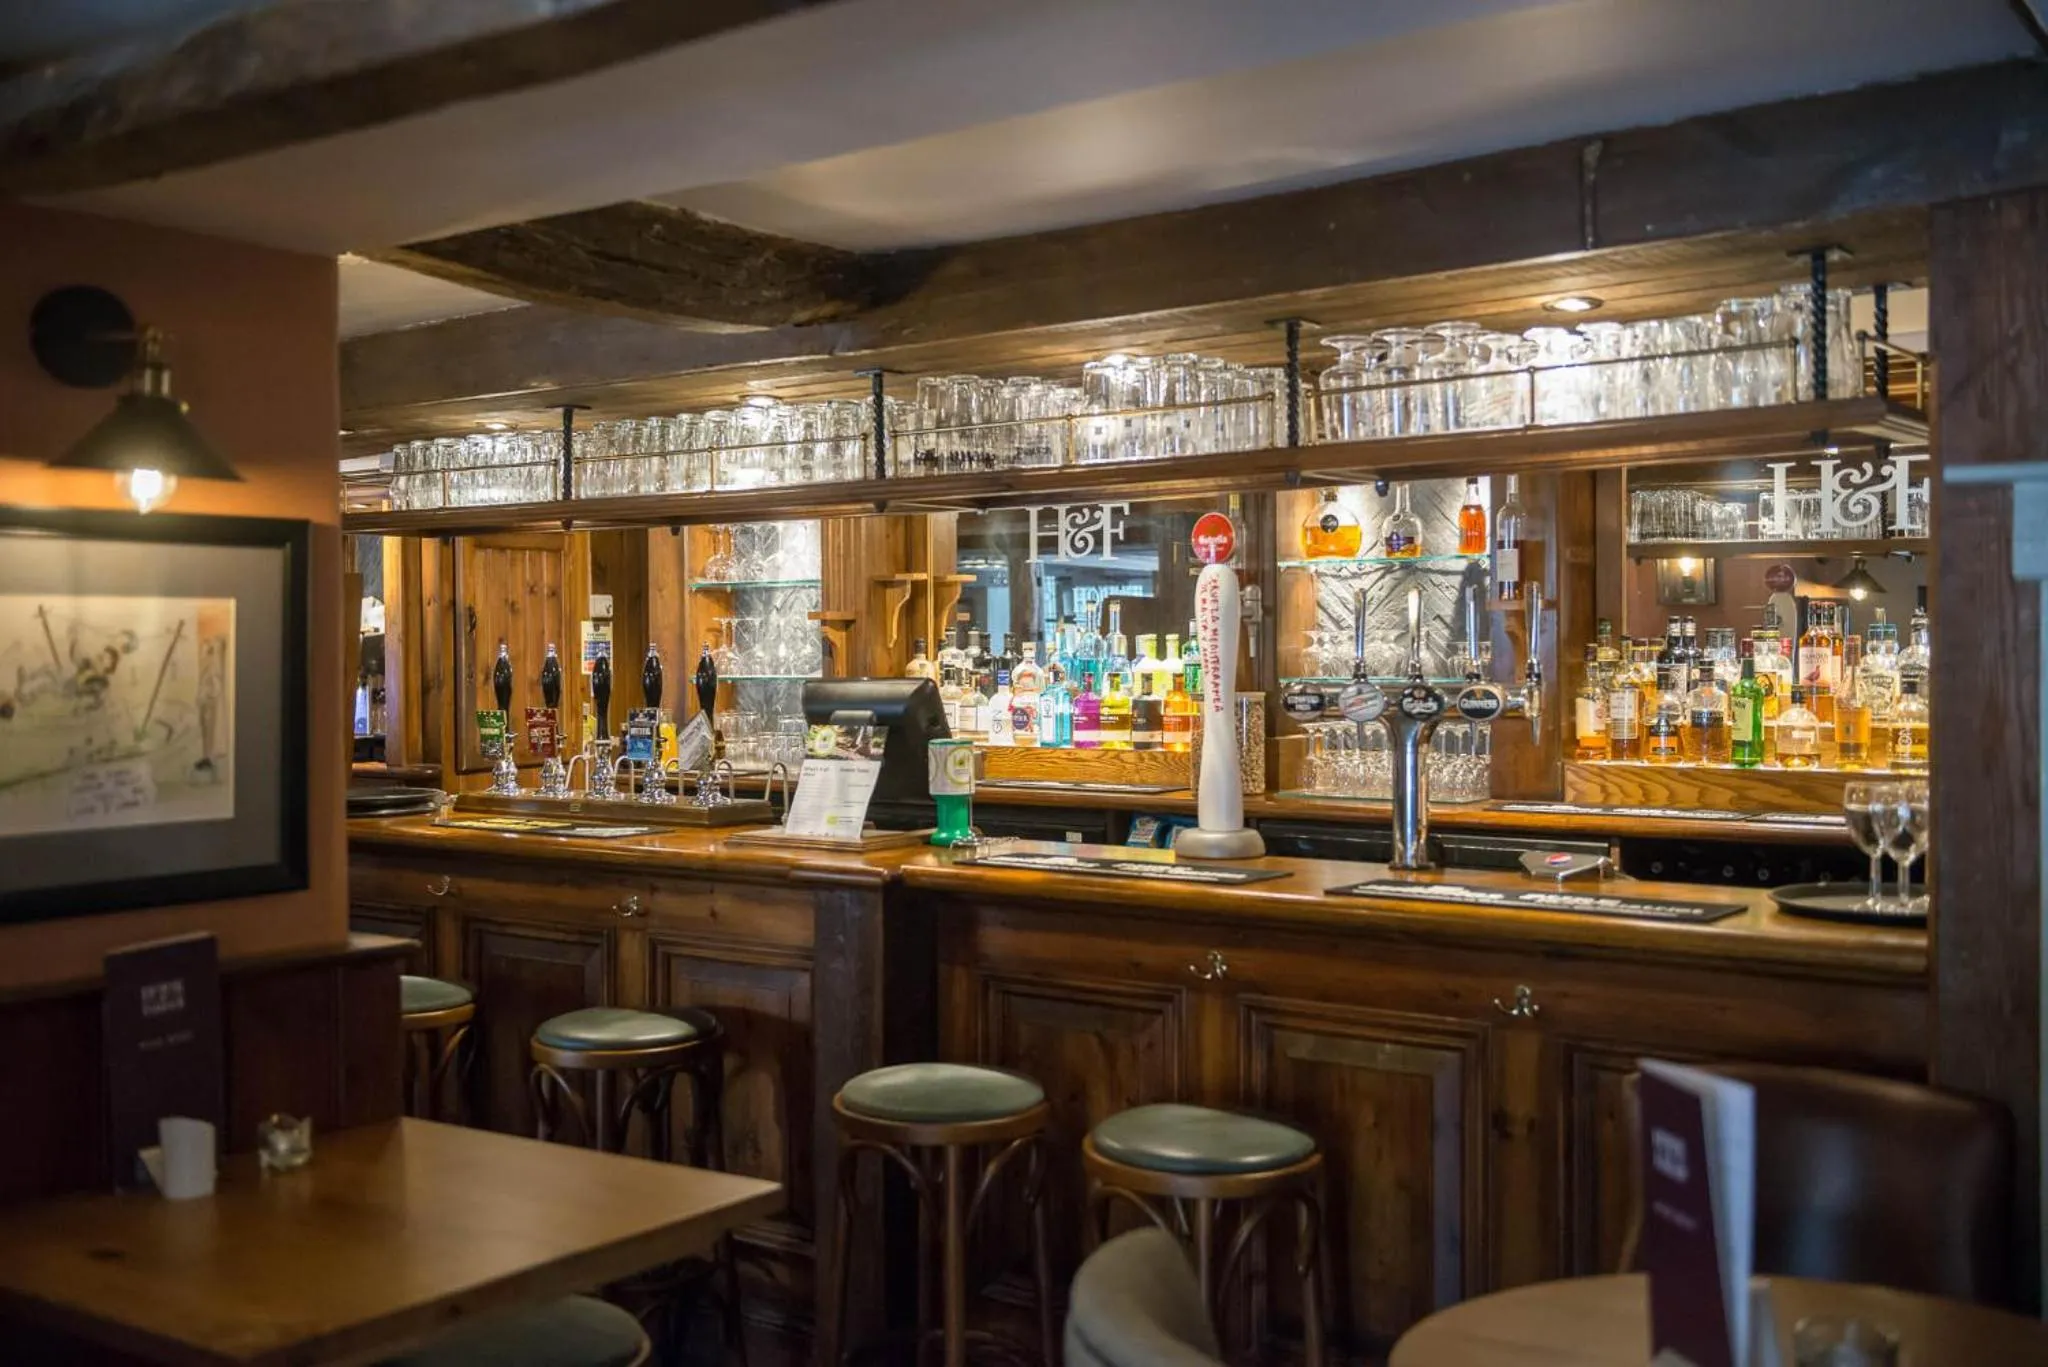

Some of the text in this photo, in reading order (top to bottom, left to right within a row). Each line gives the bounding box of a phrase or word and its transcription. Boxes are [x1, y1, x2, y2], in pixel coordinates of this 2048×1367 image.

[1766, 454, 1931, 535] H&F
[1024, 502, 1131, 563] H&F
[1460, 697, 1498, 709] GUINNESS
